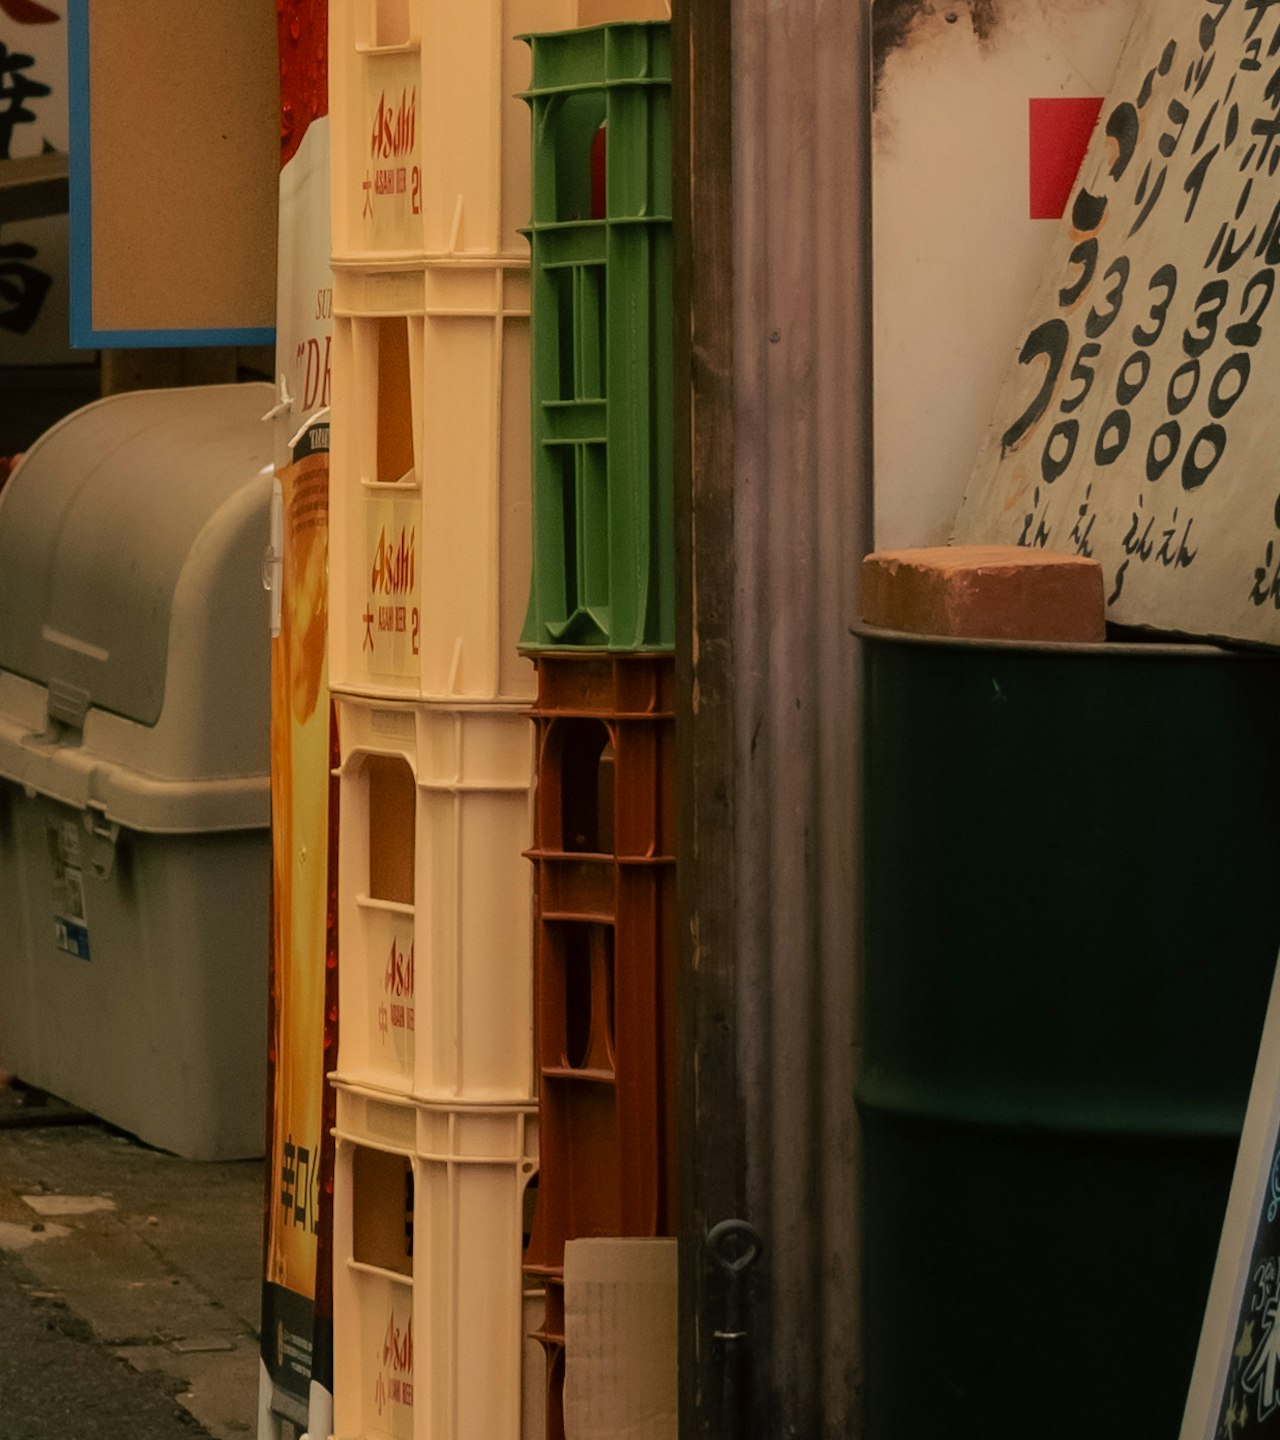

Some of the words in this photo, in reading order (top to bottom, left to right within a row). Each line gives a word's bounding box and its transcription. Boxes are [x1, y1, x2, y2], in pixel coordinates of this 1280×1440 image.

[371, 84, 416, 160] Asahi
[371, 523, 416, 596] Asahi
[362, 602, 375, 654] 大
